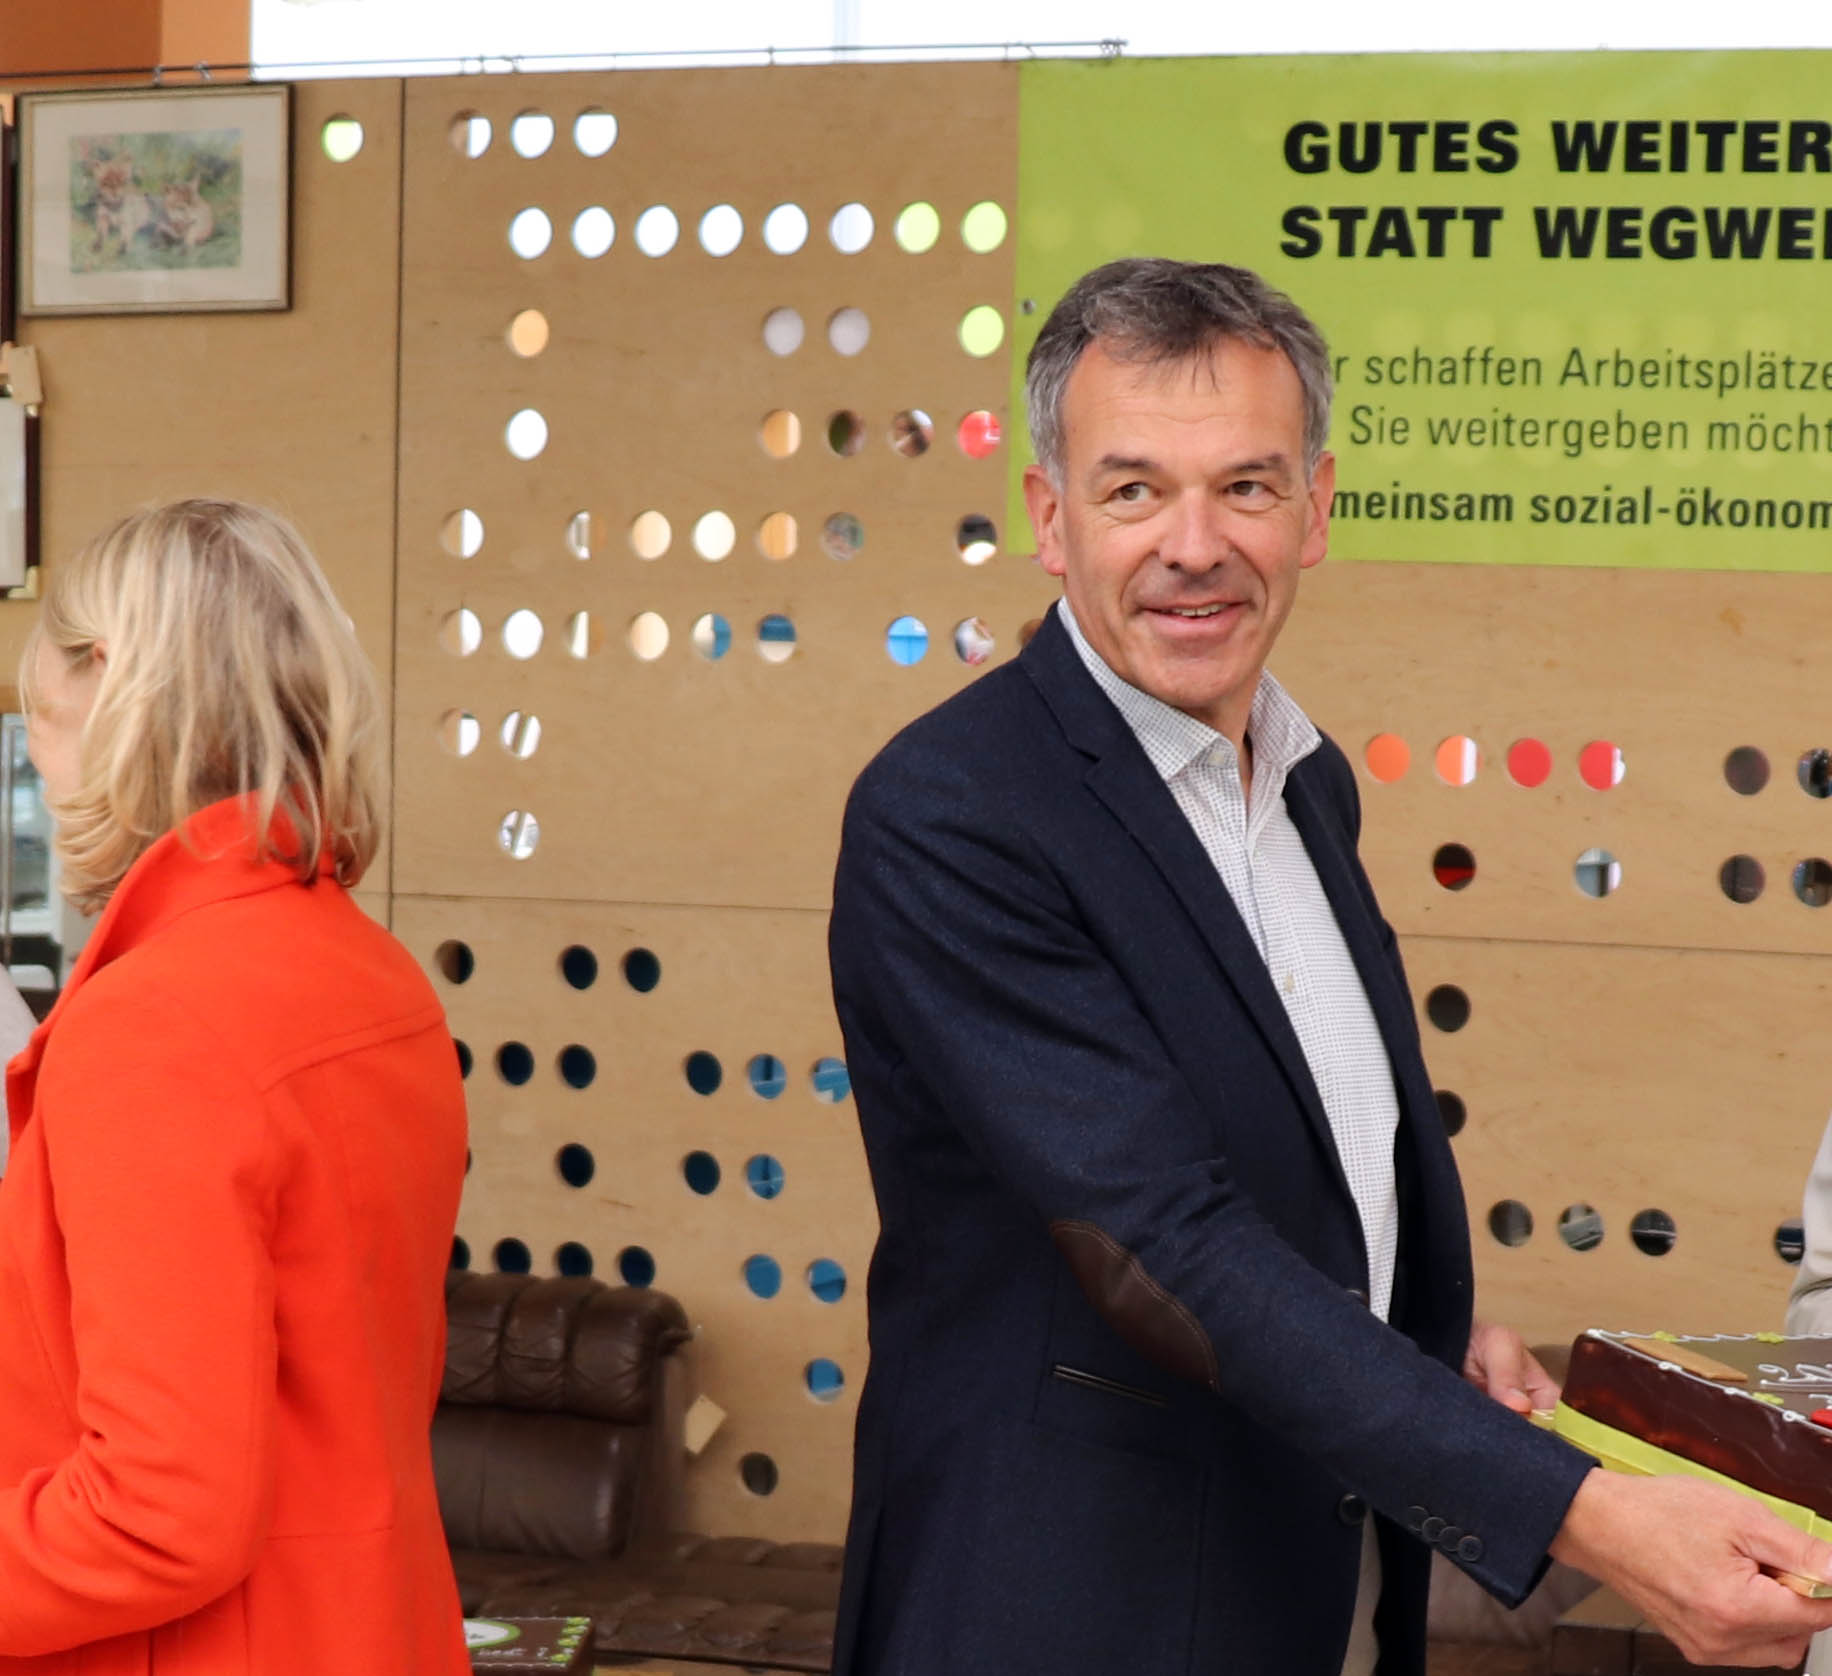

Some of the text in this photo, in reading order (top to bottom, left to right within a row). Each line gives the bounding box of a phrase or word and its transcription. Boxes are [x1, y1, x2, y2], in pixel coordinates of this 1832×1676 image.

[1283, 119, 1519, 174] GUTES
[1279, 205, 1504, 260] STATT
[1363, 346, 1543, 386] schaffen
[1349, 405, 1411, 446] Sie
[1427, 407, 1690, 458] weitergeben
[1328, 481, 1515, 523] meinsam
